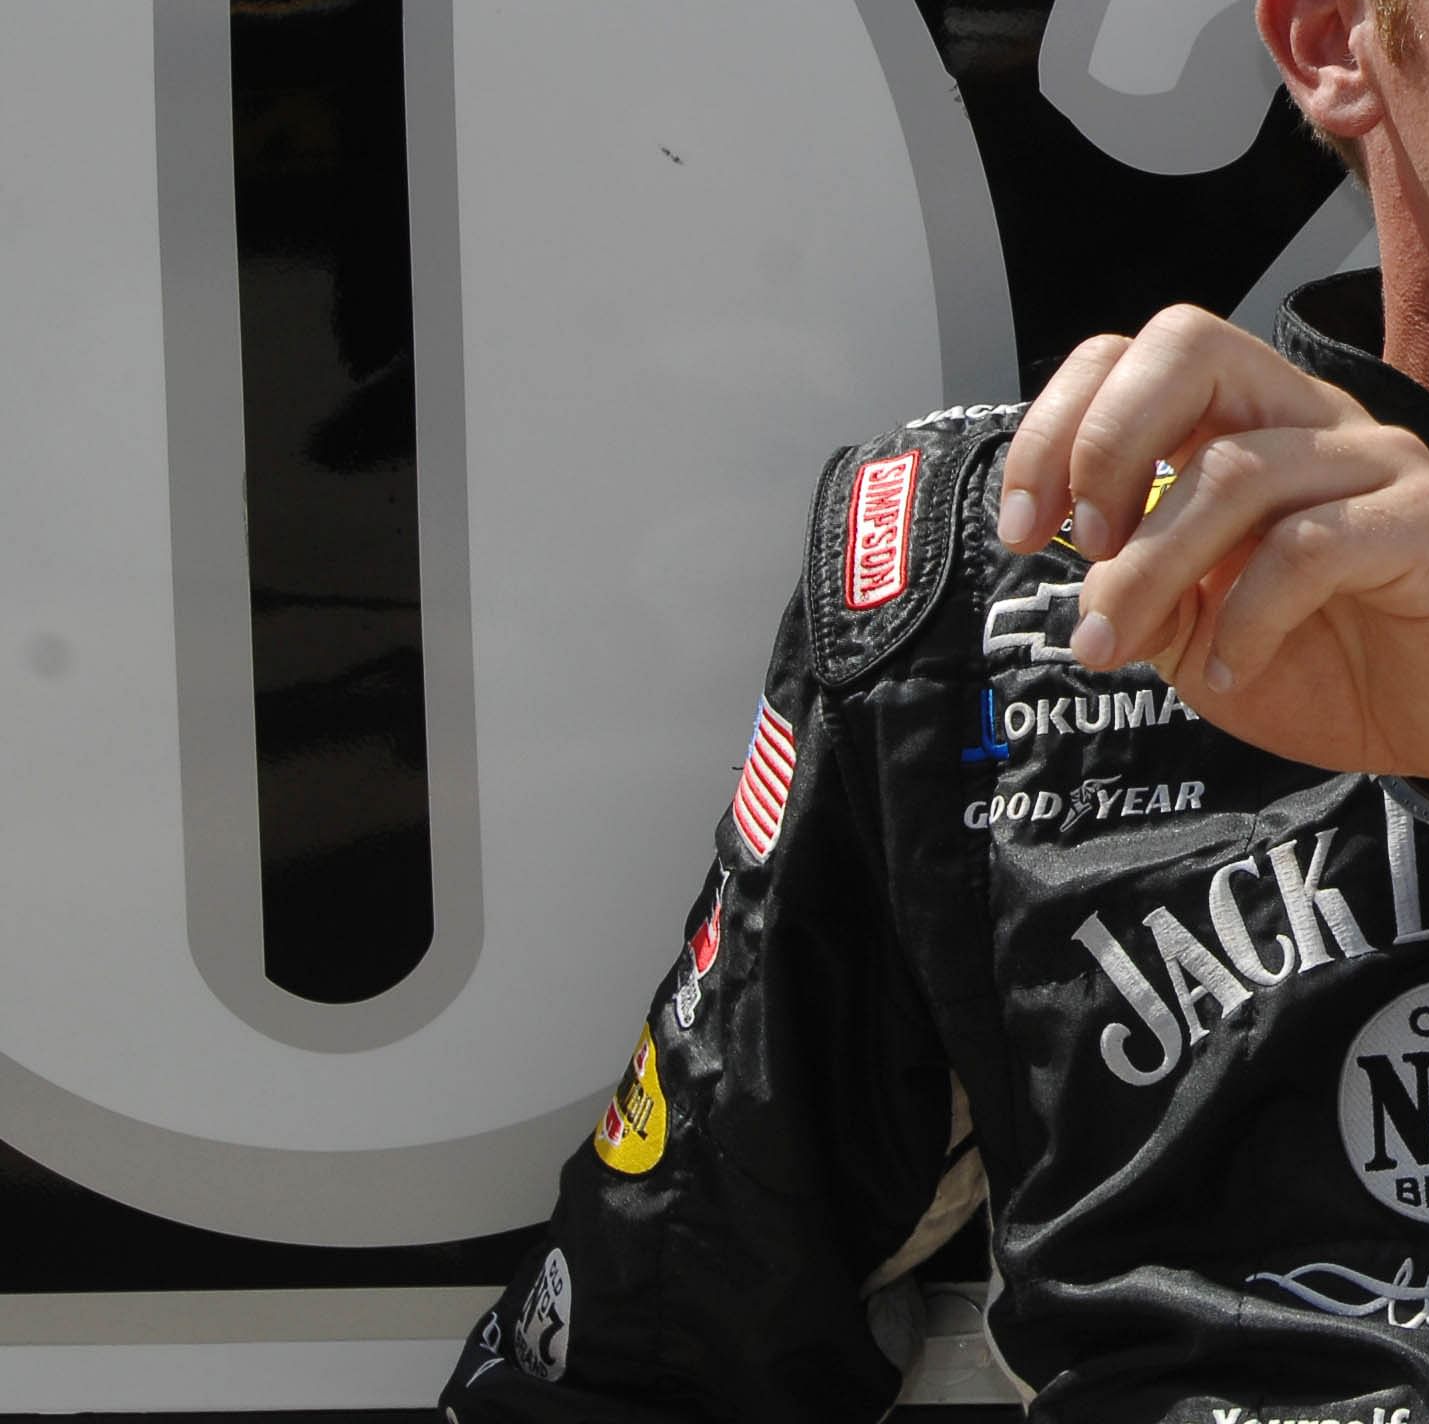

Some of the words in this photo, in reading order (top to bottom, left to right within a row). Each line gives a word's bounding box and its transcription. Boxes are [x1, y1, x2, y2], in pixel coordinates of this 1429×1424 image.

[860, 463, 906, 593] SIMPSON
[1004, 686, 1200, 741] OKUMA
[1071, 827, 1379, 1087] JACK
